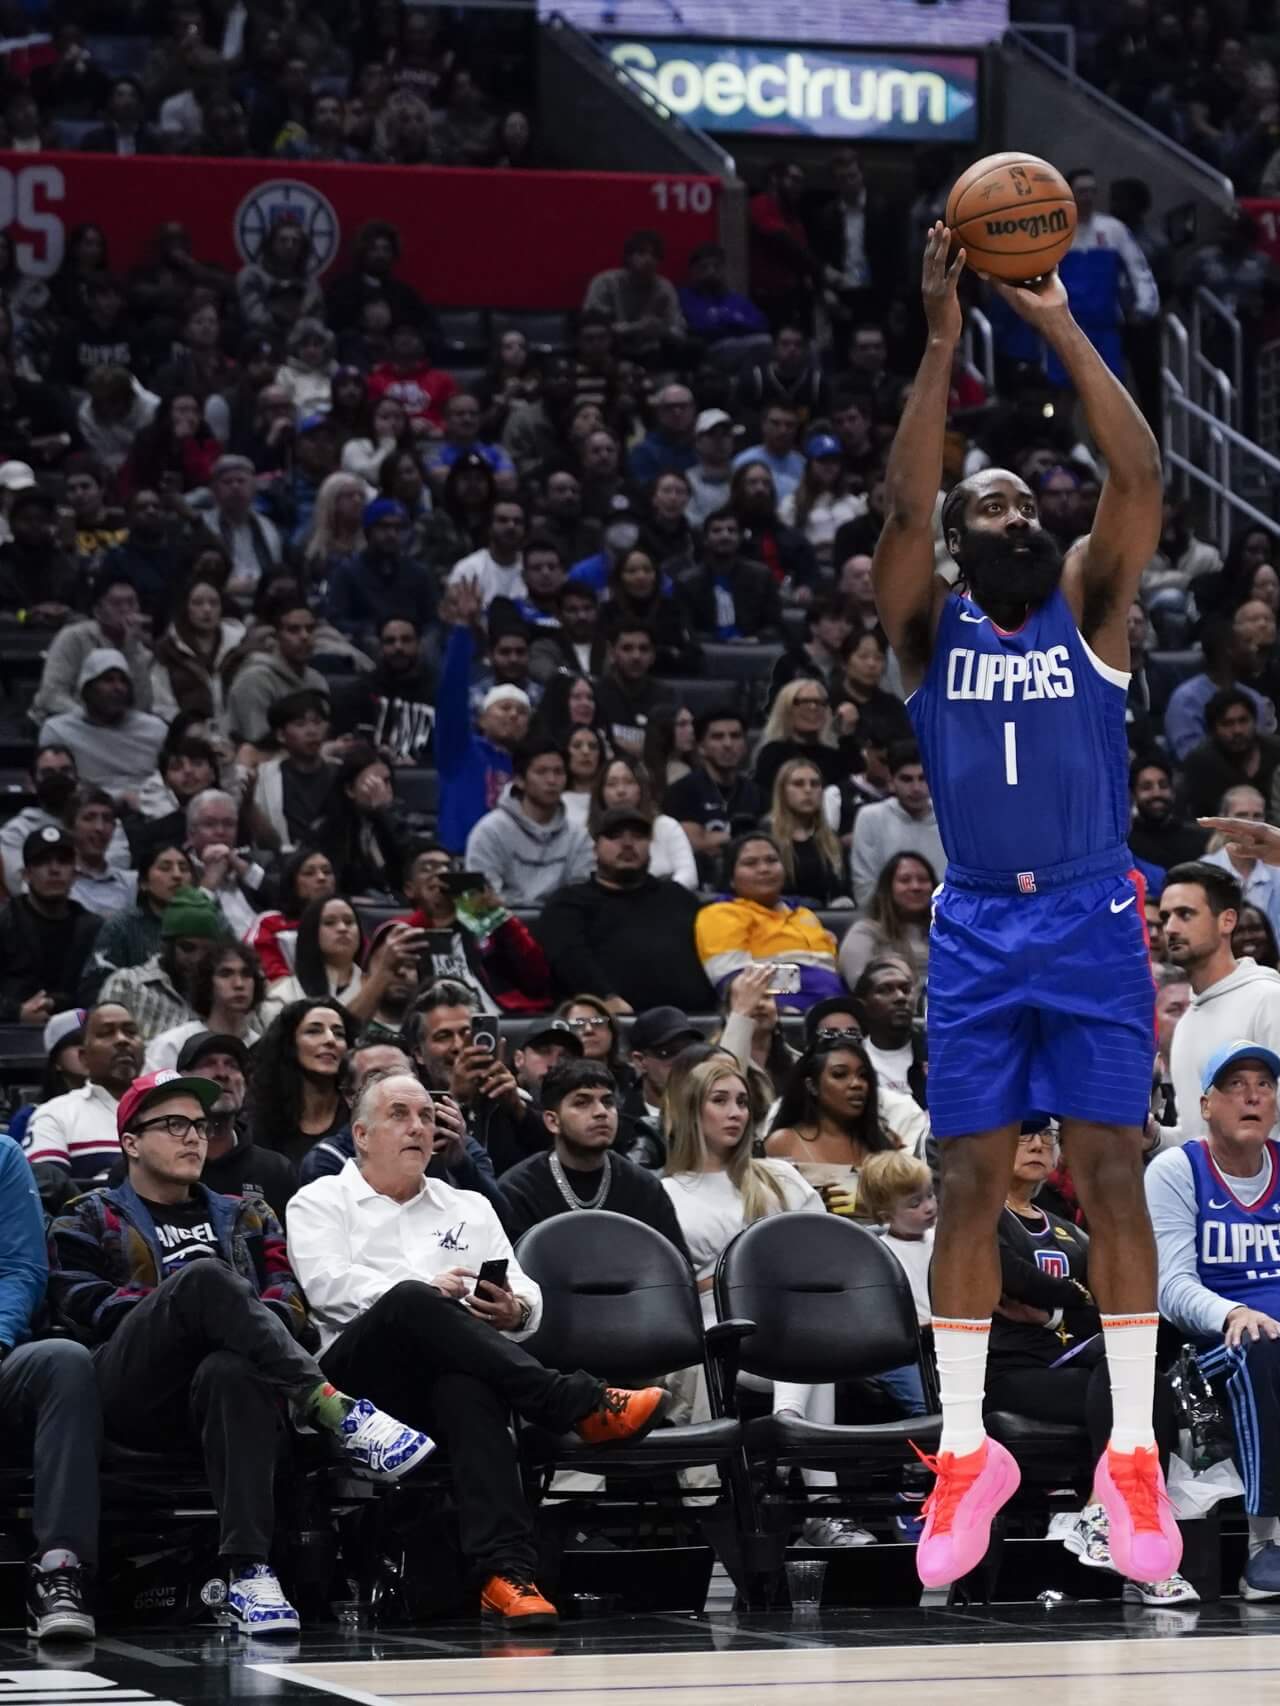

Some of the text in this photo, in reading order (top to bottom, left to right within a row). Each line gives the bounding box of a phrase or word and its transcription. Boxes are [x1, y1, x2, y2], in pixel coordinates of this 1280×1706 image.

[651, 182, 712, 212] 110
[947, 645, 1075, 701] CLIPPERS
[1004, 721, 1018, 785] 1
